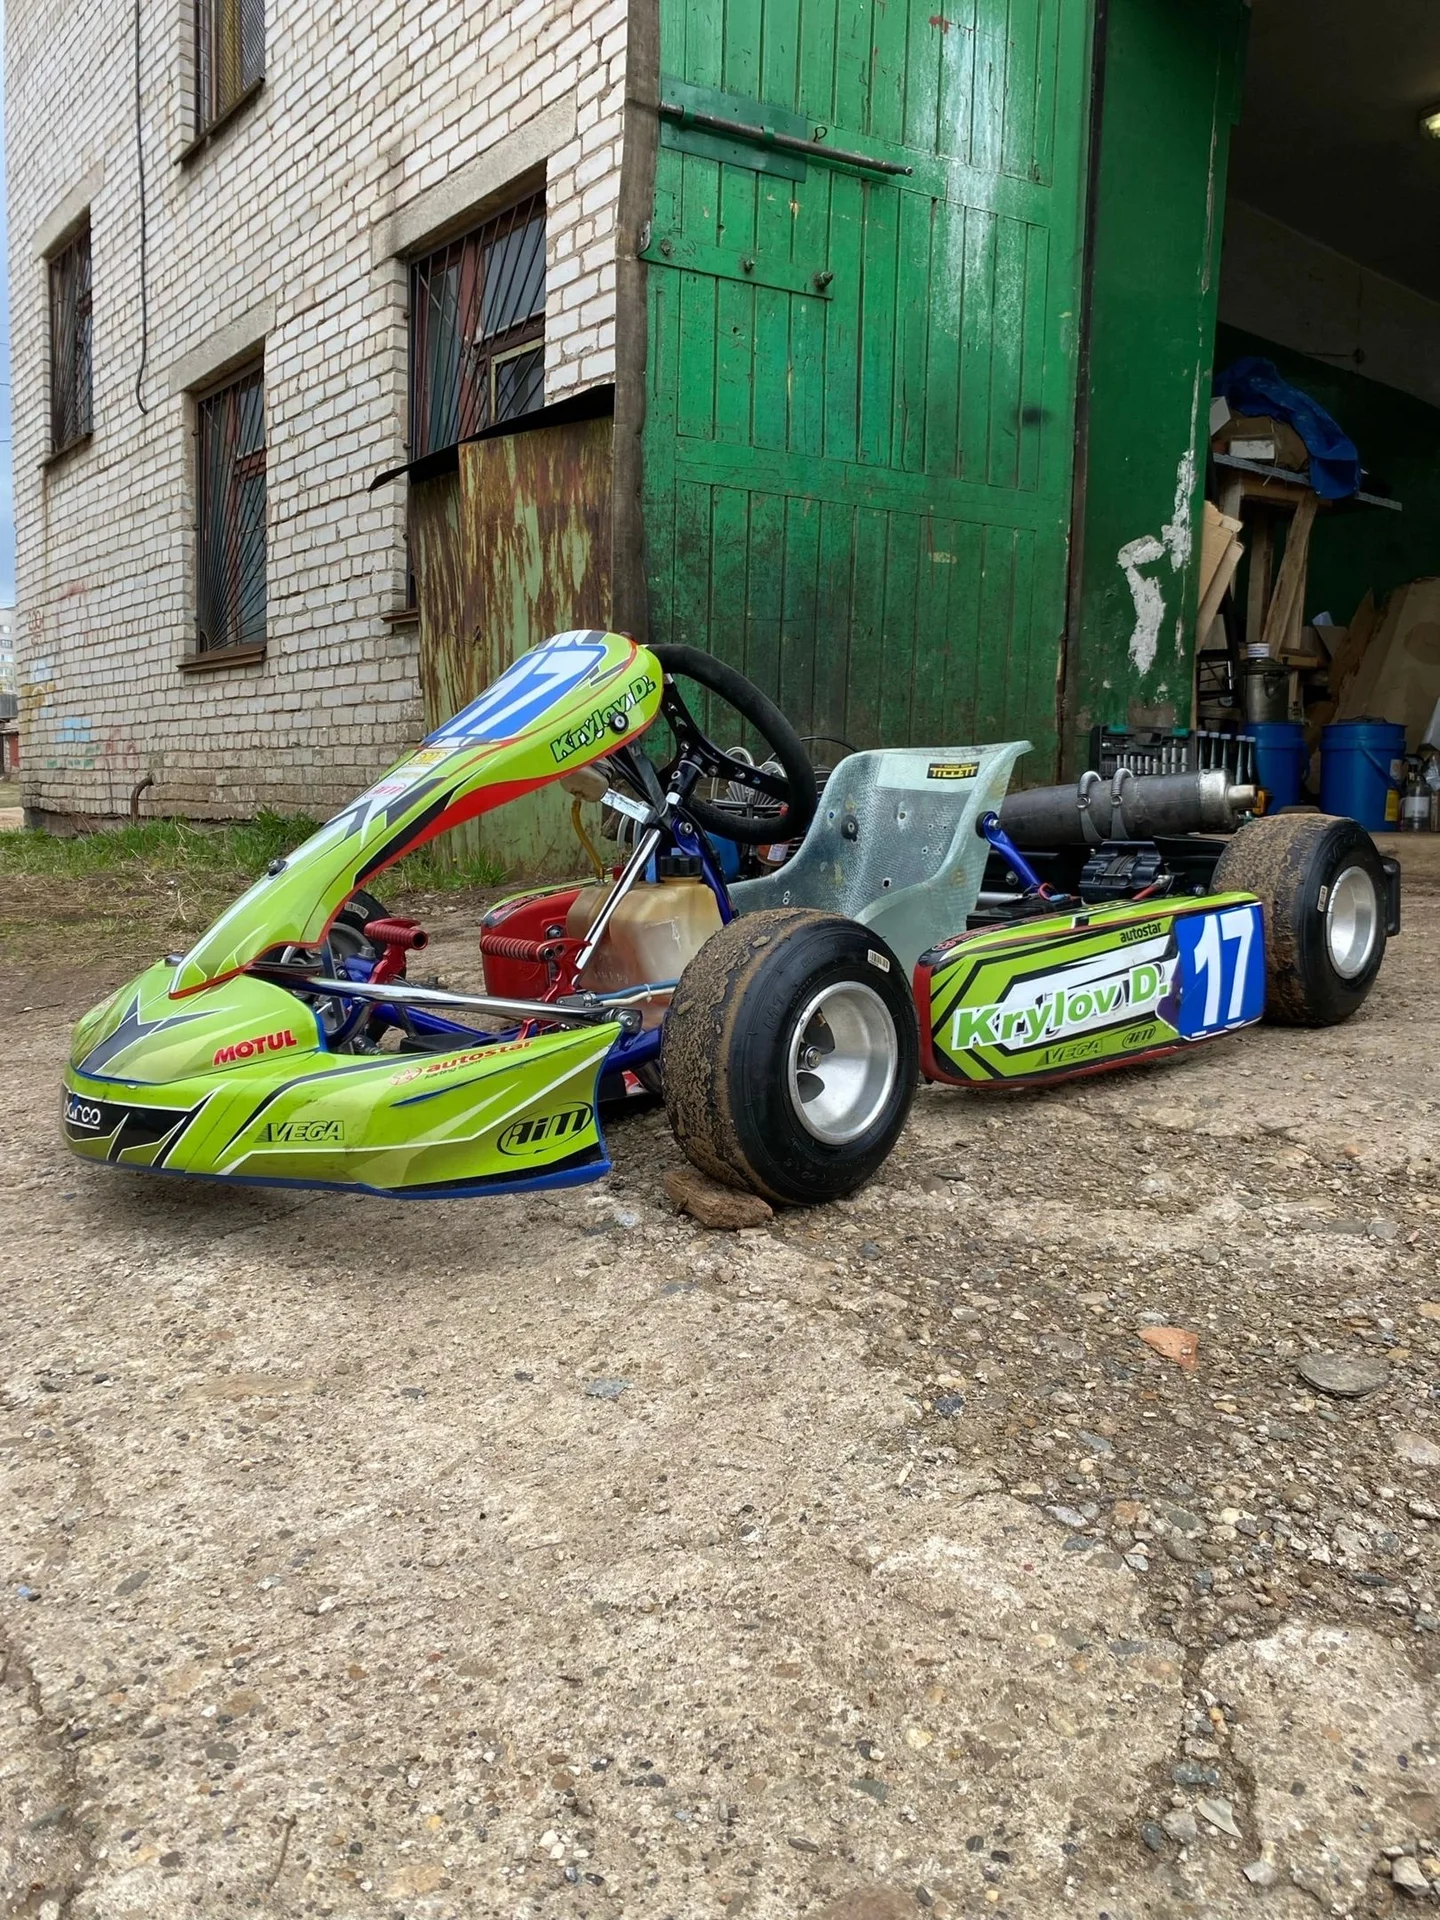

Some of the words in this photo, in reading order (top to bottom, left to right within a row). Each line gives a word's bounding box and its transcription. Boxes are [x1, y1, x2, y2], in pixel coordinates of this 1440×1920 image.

[438, 650, 601, 738] 17
[1119, 922, 1162, 943] autostar
[1193, 907, 1254, 1027] 17
[953, 984, 1118, 1050] Krylov
[1130, 963, 1168, 1004] D.
[212, 1029, 298, 1066] MOTUL
[425, 1041, 532, 1074] autostar
[1046, 1039, 1103, 1064] VEGA
[267, 1120, 345, 1142] VEGA
